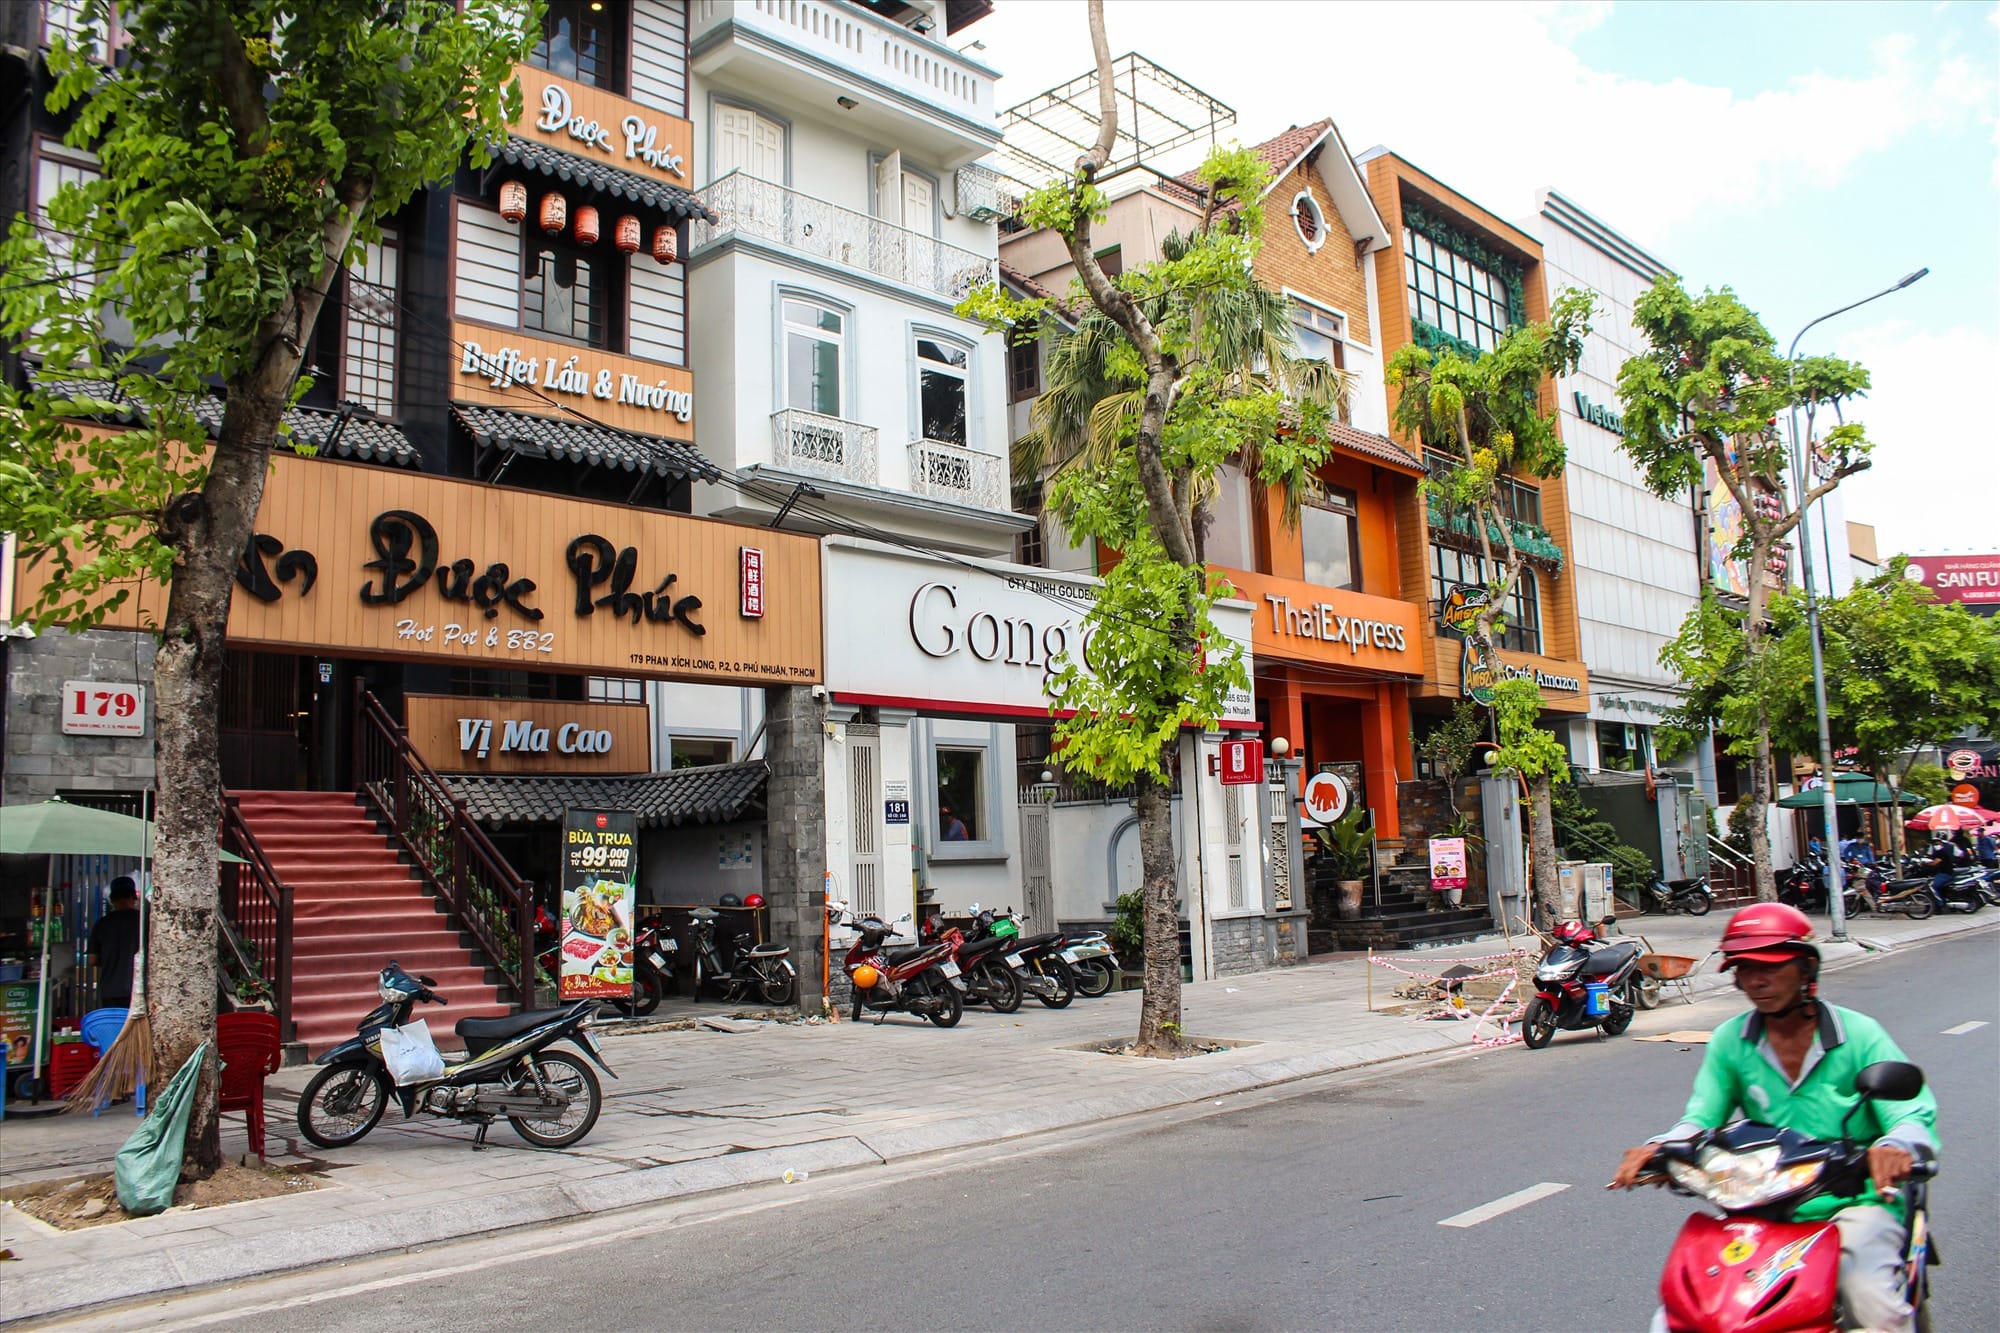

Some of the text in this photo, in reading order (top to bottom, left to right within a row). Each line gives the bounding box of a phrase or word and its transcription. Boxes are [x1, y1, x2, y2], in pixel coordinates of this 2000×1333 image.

[536, 84, 614, 153] Được
[621, 115, 686, 179] Phúc
[460, 340, 539, 389] Buffet
[592, 369, 614, 399] &
[617, 372, 693, 423] Nướng
[360, 510, 544, 620] Được
[566, 533, 706, 637] Phúc
[1936, 571, 1999, 588] SAN FU
[1029, 581, 1056, 596] TNHH
[396, 618, 435, 642] Hot
[444, 623, 479, 646] Pot
[485, 626, 498, 647] &
[1264, 592, 1406, 655] ThaiExpress
[630, 653, 644, 664] 179
[645, 655, 668, 666] PHAN
[671, 654, 690, 668] XÍCH
[692, 659, 717, 672] LONG,
[733, 662, 742, 672] Q.
[743, 661, 758, 673] PHÚ
[789, 667, 815, 678] TP.HCM
[1536, 669, 1580, 691] Amazon
[72, 690, 137, 718] 179
[457, 719, 612, 758] Vị Ma Cao
[889, 802, 905, 813] 181
[597, 832, 633, 846] TRƯA
